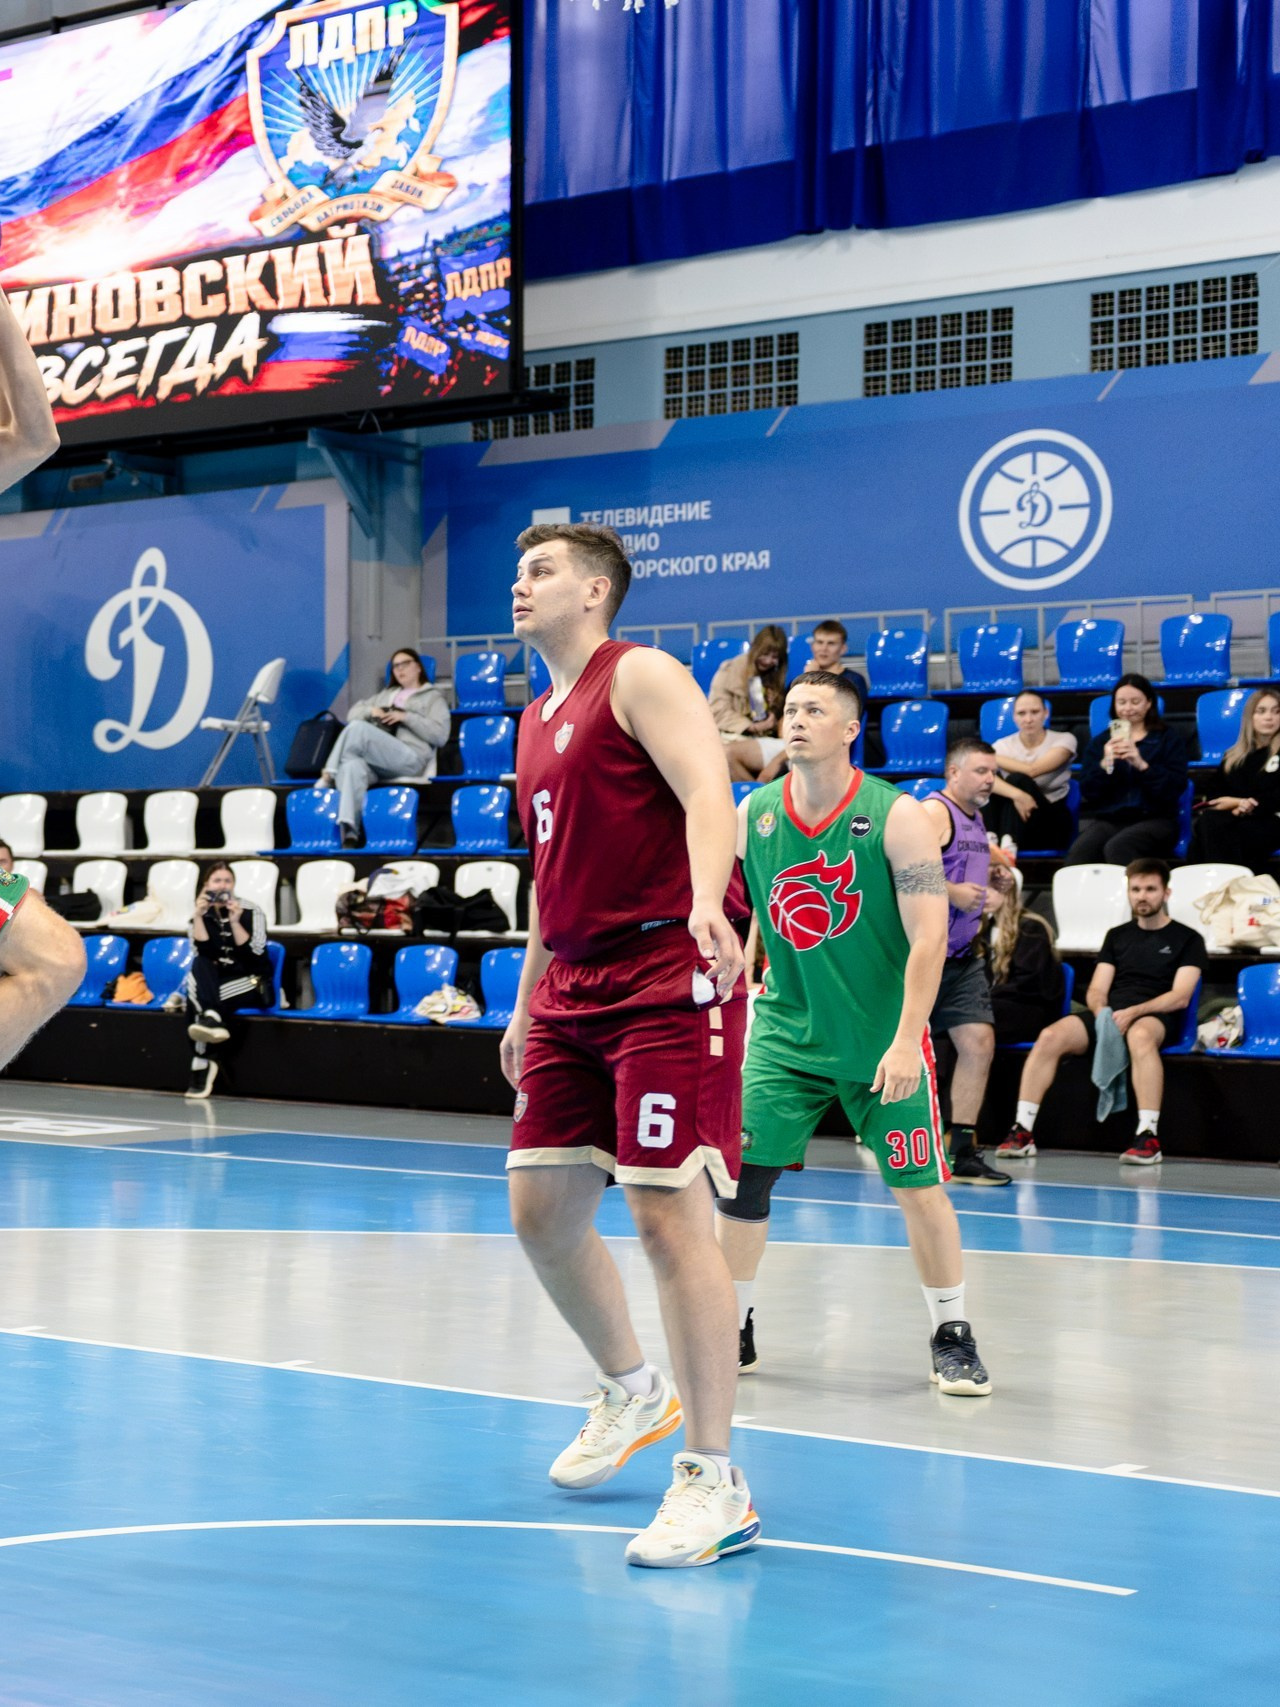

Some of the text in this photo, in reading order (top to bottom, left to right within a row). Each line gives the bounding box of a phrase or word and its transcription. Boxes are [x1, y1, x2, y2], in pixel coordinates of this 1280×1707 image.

[285, 0, 418, 70] ЛДПР
[444, 257, 511, 301] ЛДПР
[580, 500, 712, 528] ТЕЛЕВИДЕНИЕ
[622, 532, 660, 552] ДИО
[631, 549, 771, 580] ОРСКОГО КРАЯ
[531, 788, 554, 845] 6
[636, 1092, 677, 1149] 6
[885, 1127, 930, 1169] 30
